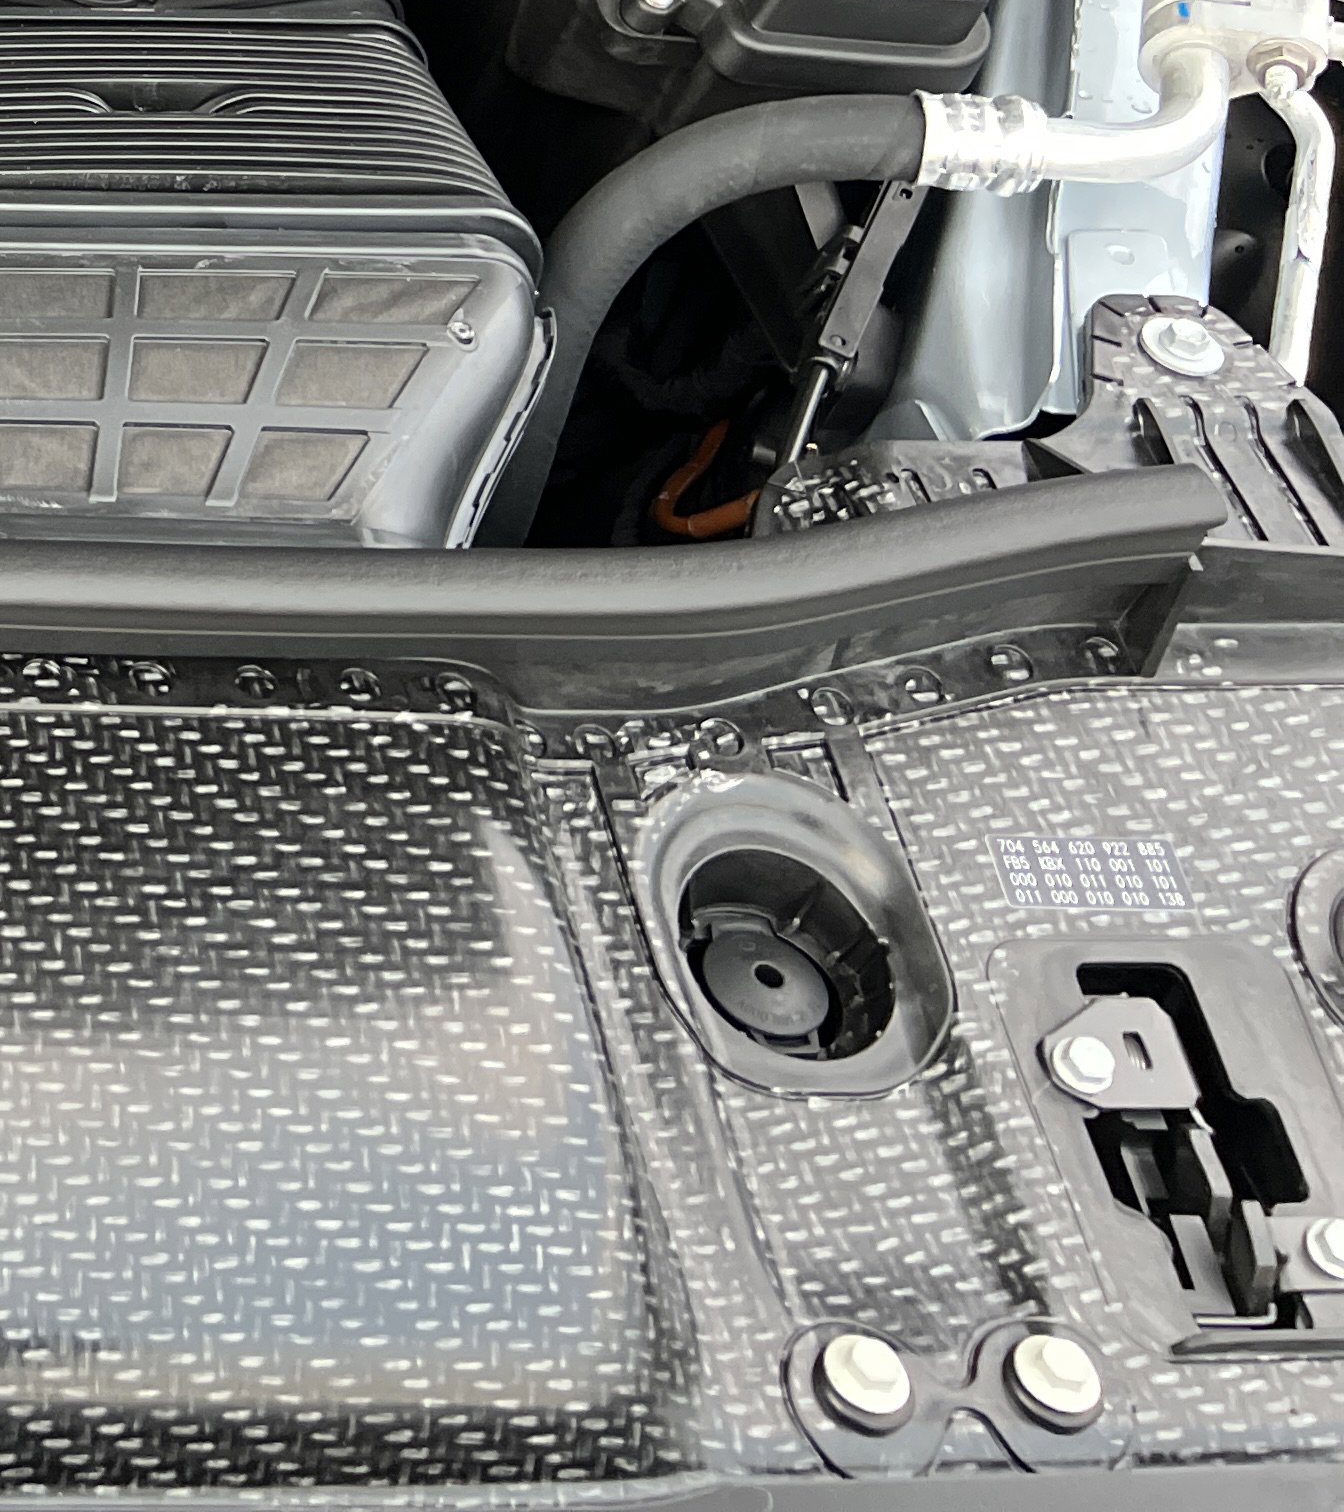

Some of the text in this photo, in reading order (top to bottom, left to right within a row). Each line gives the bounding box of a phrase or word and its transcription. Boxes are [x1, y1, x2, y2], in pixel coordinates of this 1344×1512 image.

[997, 839, 1024, 853] 704
[1032, 840, 1060, 853] 564
[1068, 841, 1095, 855] 620
[1102, 842, 1130, 855] 922
[1076, 858, 1101, 871] 110
[1109, 859, 1136, 872] 001
[1146, 859, 1170, 873] 101
[1010, 872, 1177, 889] 000 010 011 010 101
[1015, 889, 1042, 903] 011
[1051, 891, 1078, 904] 000
[1086, 891, 1114, 905] 010
[1122, 892, 1149, 906] 010
